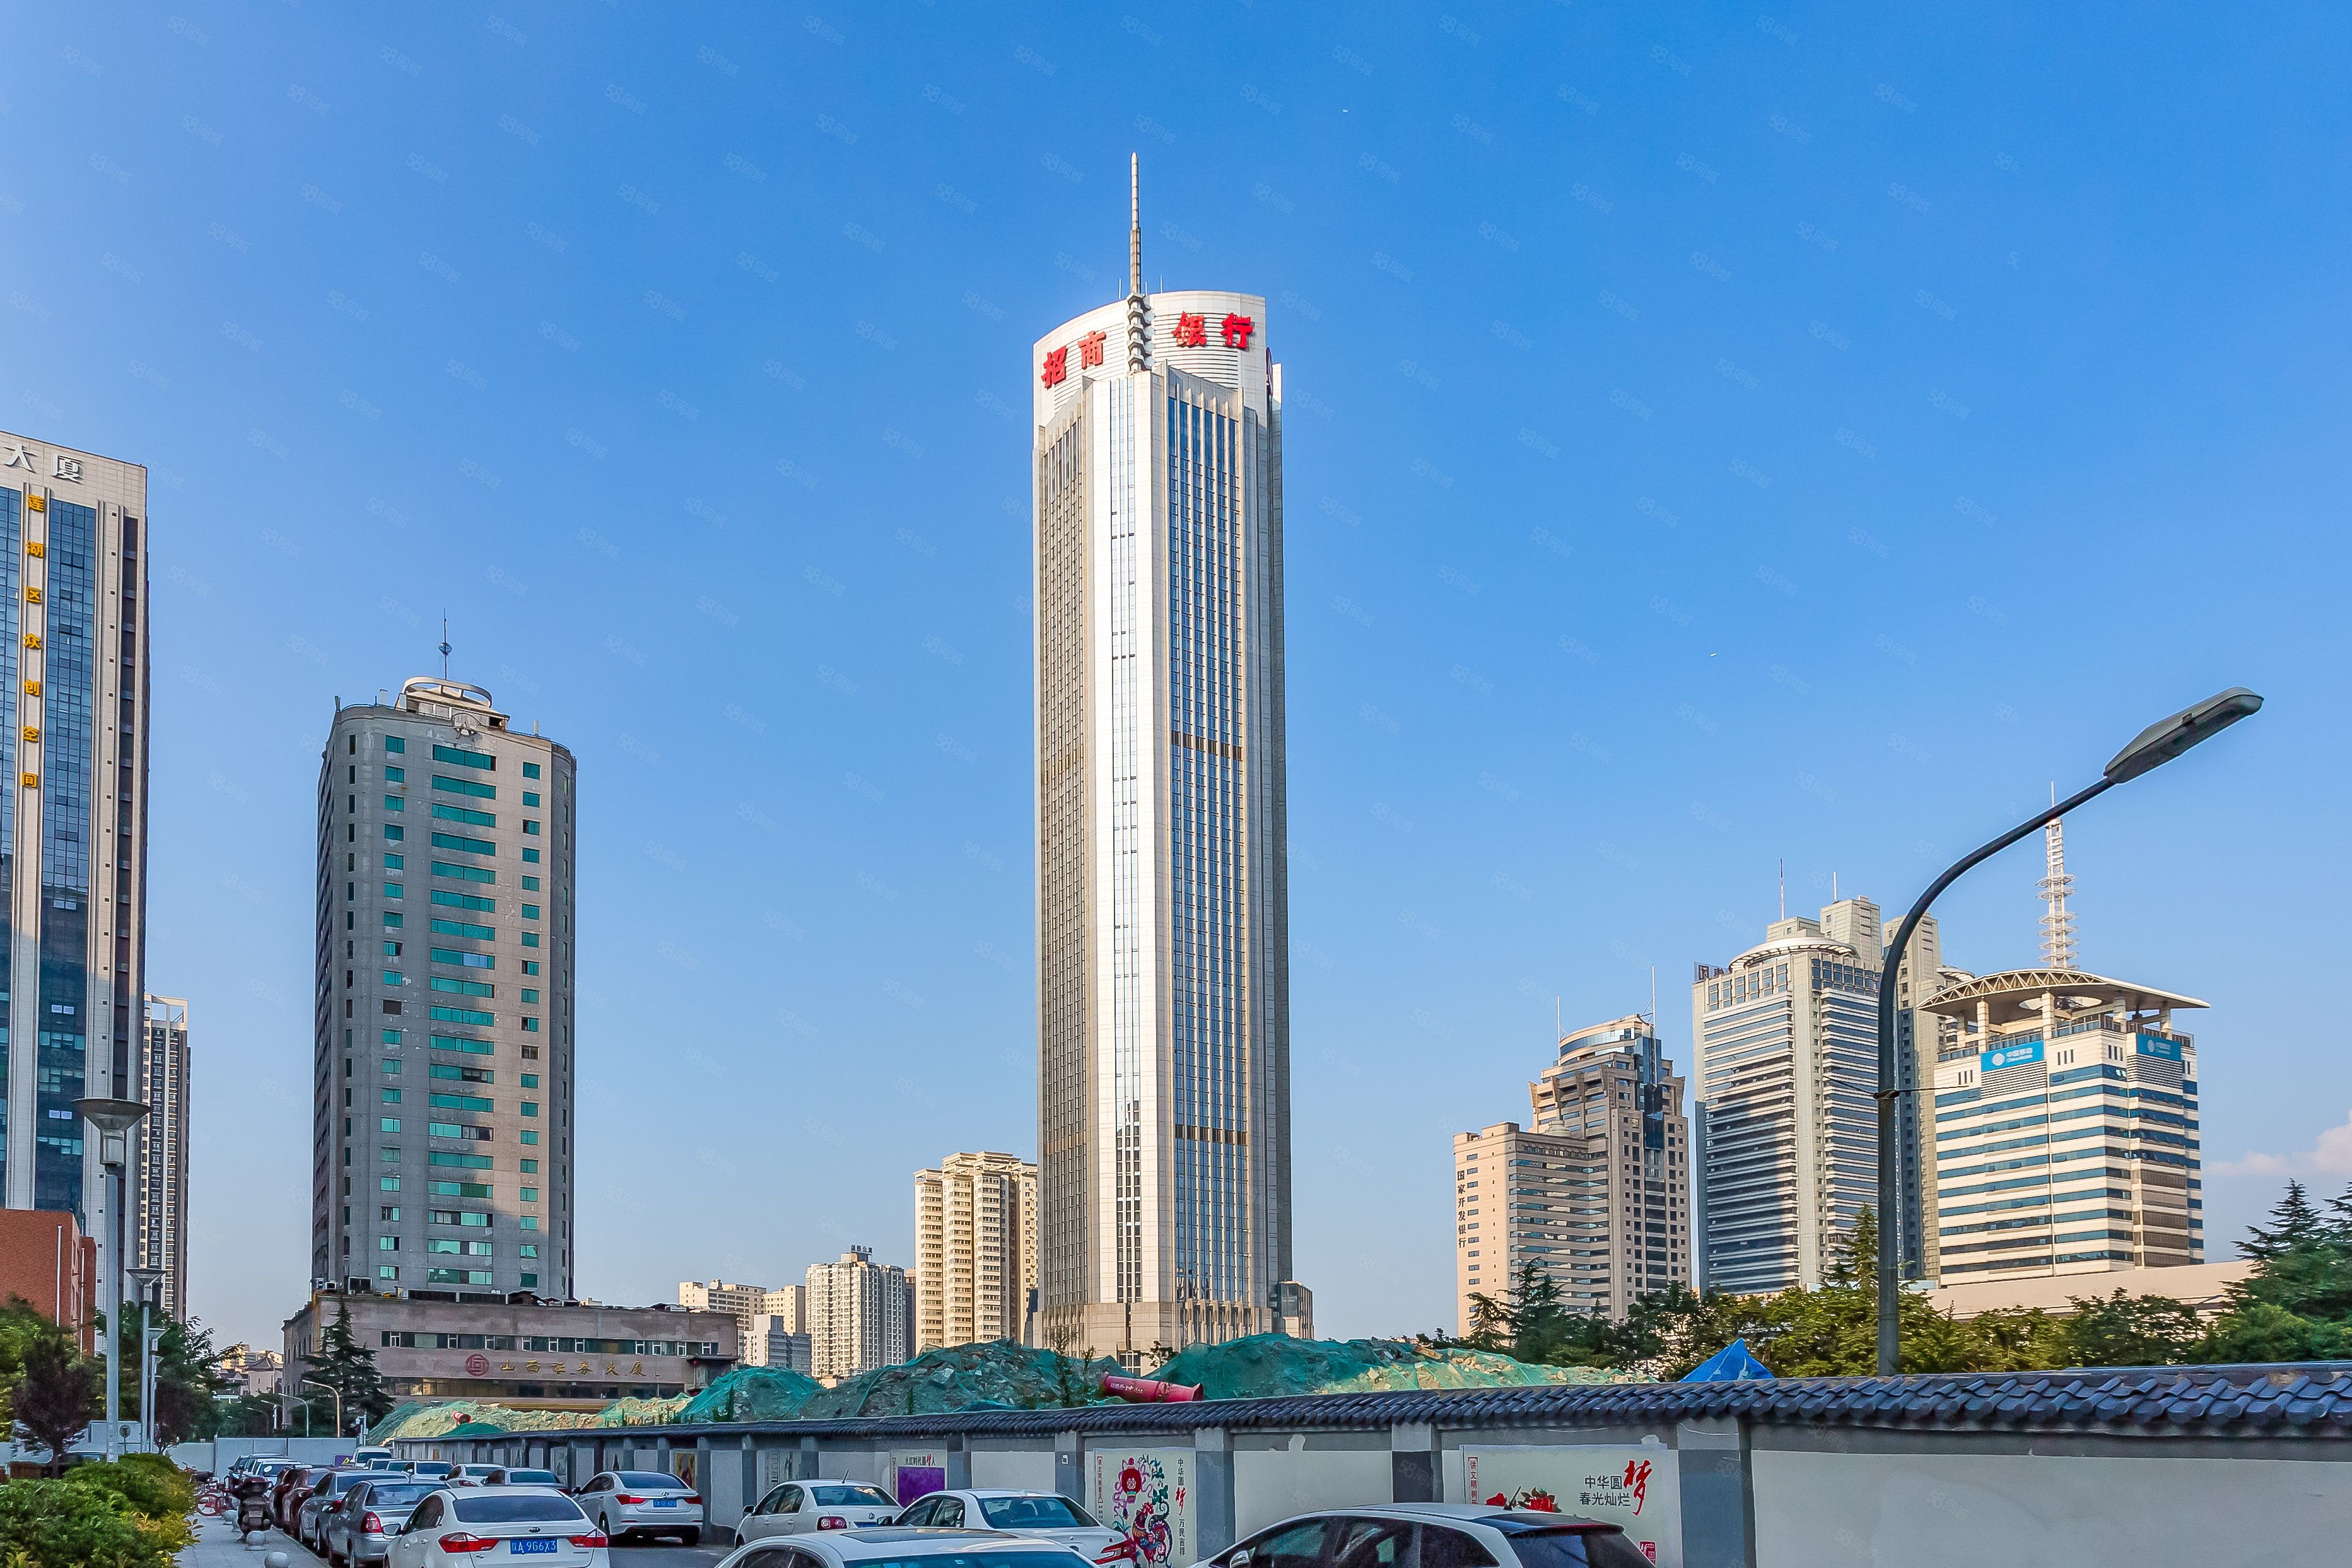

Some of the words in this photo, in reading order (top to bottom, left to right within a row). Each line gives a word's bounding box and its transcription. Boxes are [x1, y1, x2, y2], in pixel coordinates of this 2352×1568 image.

[4, 443, 83, 485] 大厦
[500, 1359, 647, 1377] 山西证券大厦
[1579, 1492, 1630, 1507] 春光灿烂
